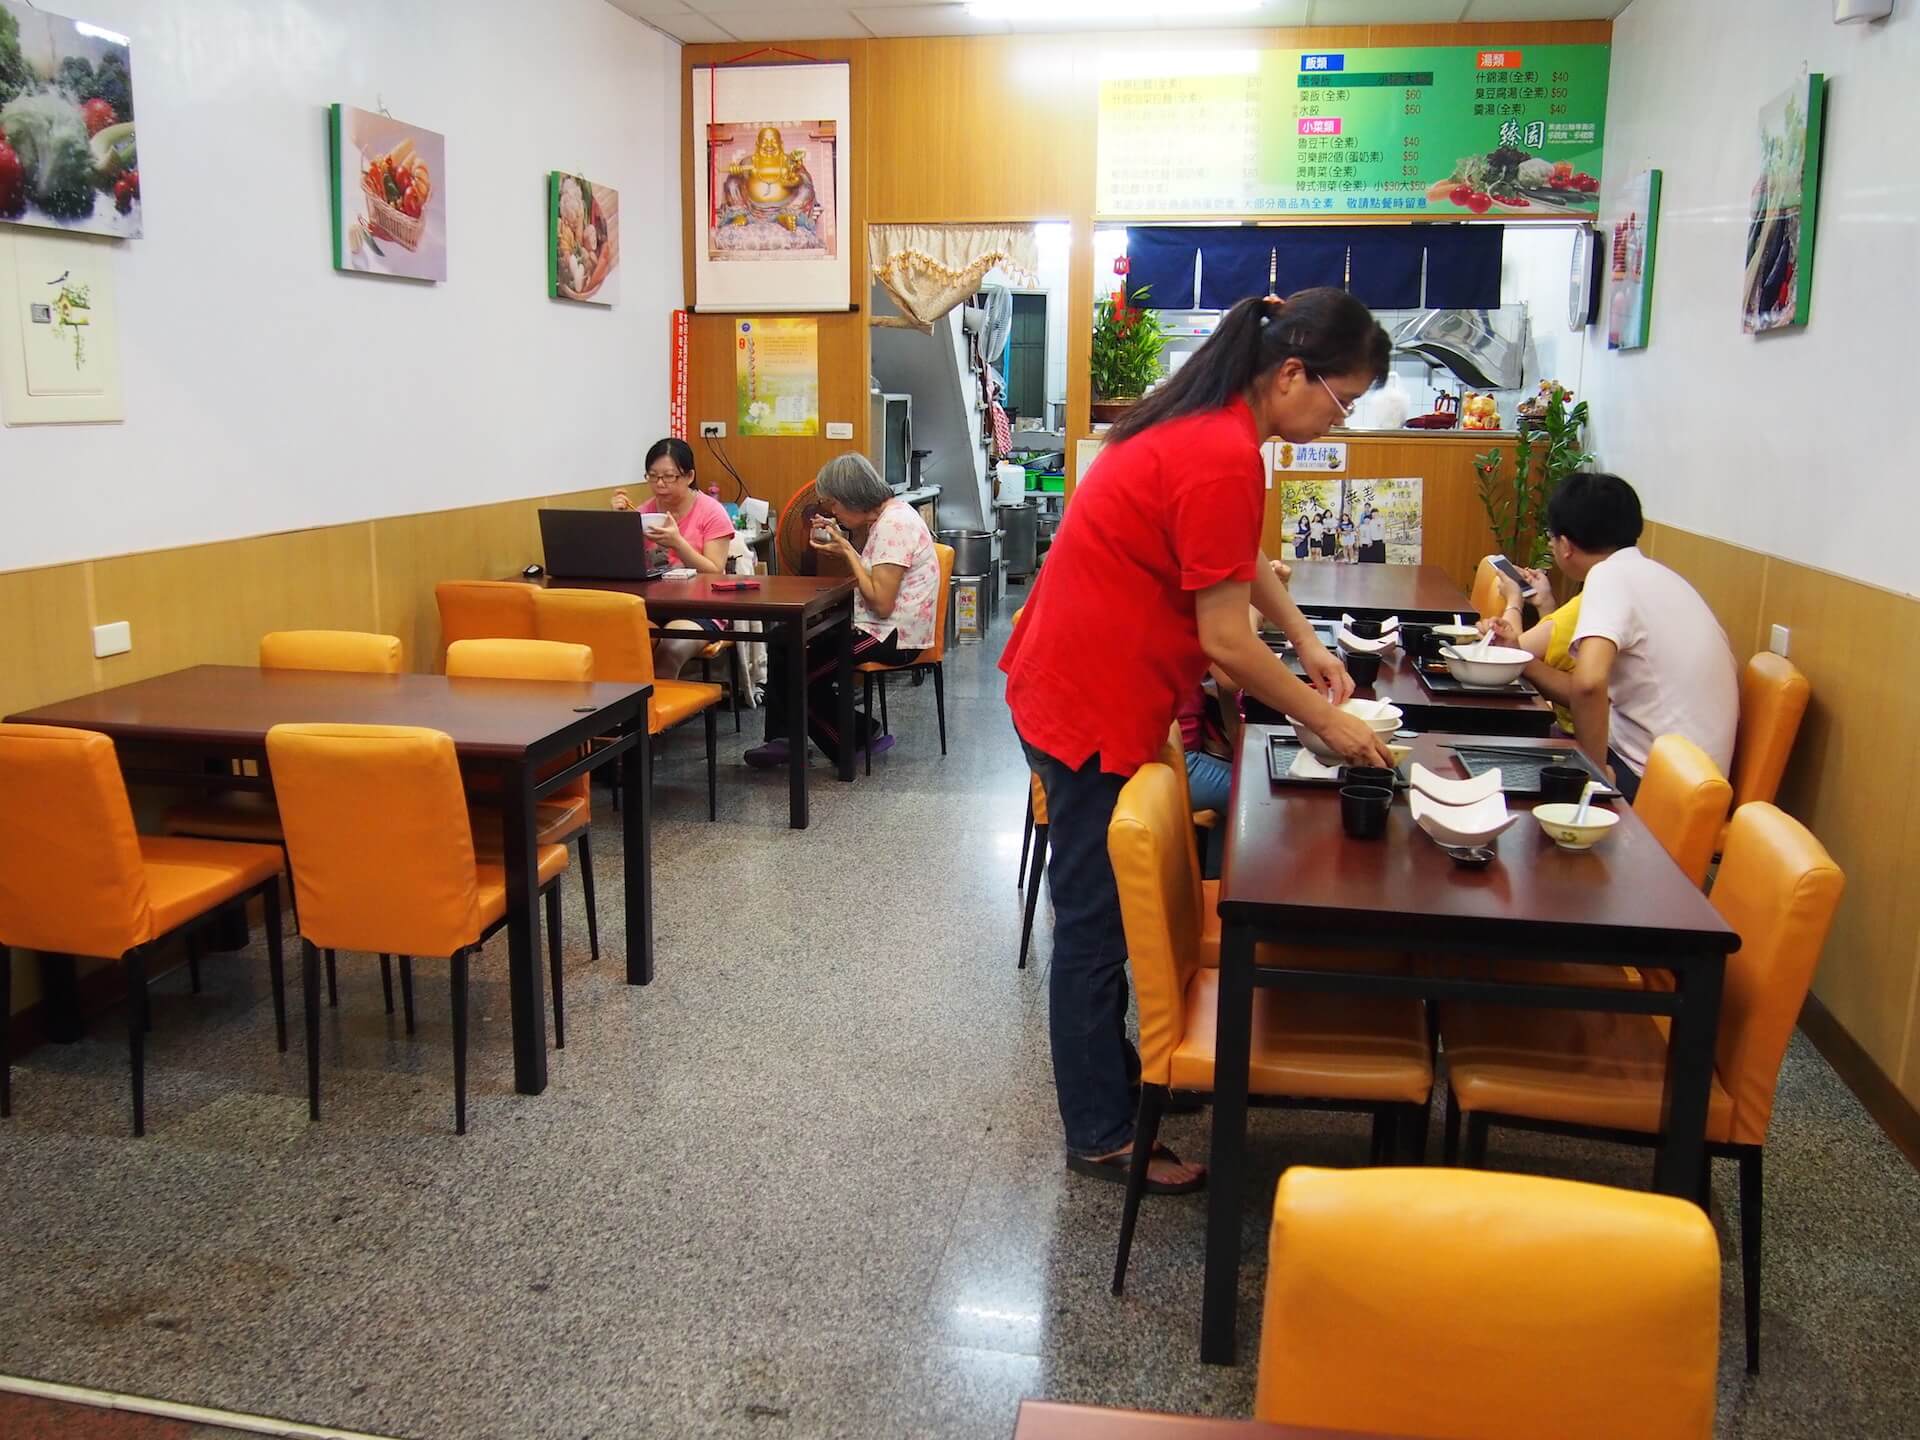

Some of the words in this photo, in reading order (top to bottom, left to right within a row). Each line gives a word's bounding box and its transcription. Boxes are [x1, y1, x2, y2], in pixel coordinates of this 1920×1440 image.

[1305, 56, 1328, 70] 飯類
[1481, 53, 1505, 67] 湯類
[1552, 71, 1569, 82] $40
[1550, 103, 1567, 115] $40
[1302, 120, 1335, 133] 小菜類
[1404, 136, 1420, 147] $40
[1402, 166, 1417, 177] $30
[1296, 447, 1338, 461] 請先付款
